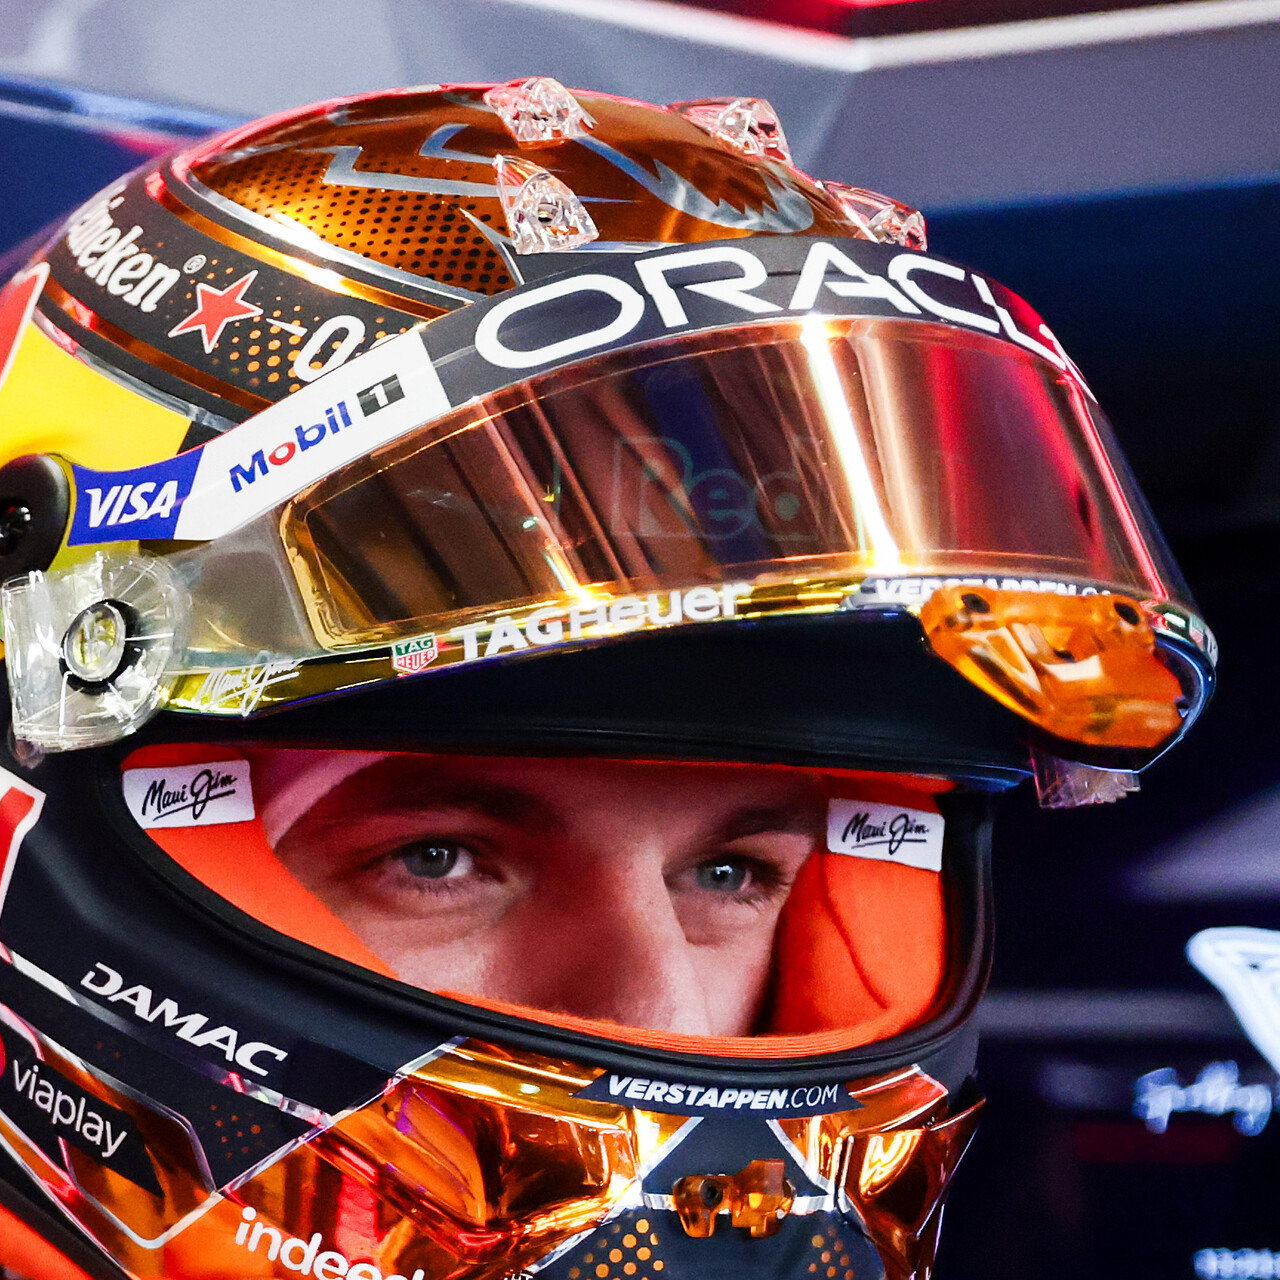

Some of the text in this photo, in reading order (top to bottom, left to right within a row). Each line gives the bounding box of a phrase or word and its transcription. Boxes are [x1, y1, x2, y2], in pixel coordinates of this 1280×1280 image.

[229, 401, 353, 494] Mobil
[85, 480, 179, 528] VISA
[395, 638, 433, 656] TAG
[395, 650, 435, 670] HEUER
[142, 769, 237, 820] Maui Jim
[842, 813, 887, 842] Maui
[81, 962, 288, 1076] DAMAC
[13, 1059, 127, 1158] viaplay
[609, 1075, 839, 1109] VERSTAPPEN.COM
